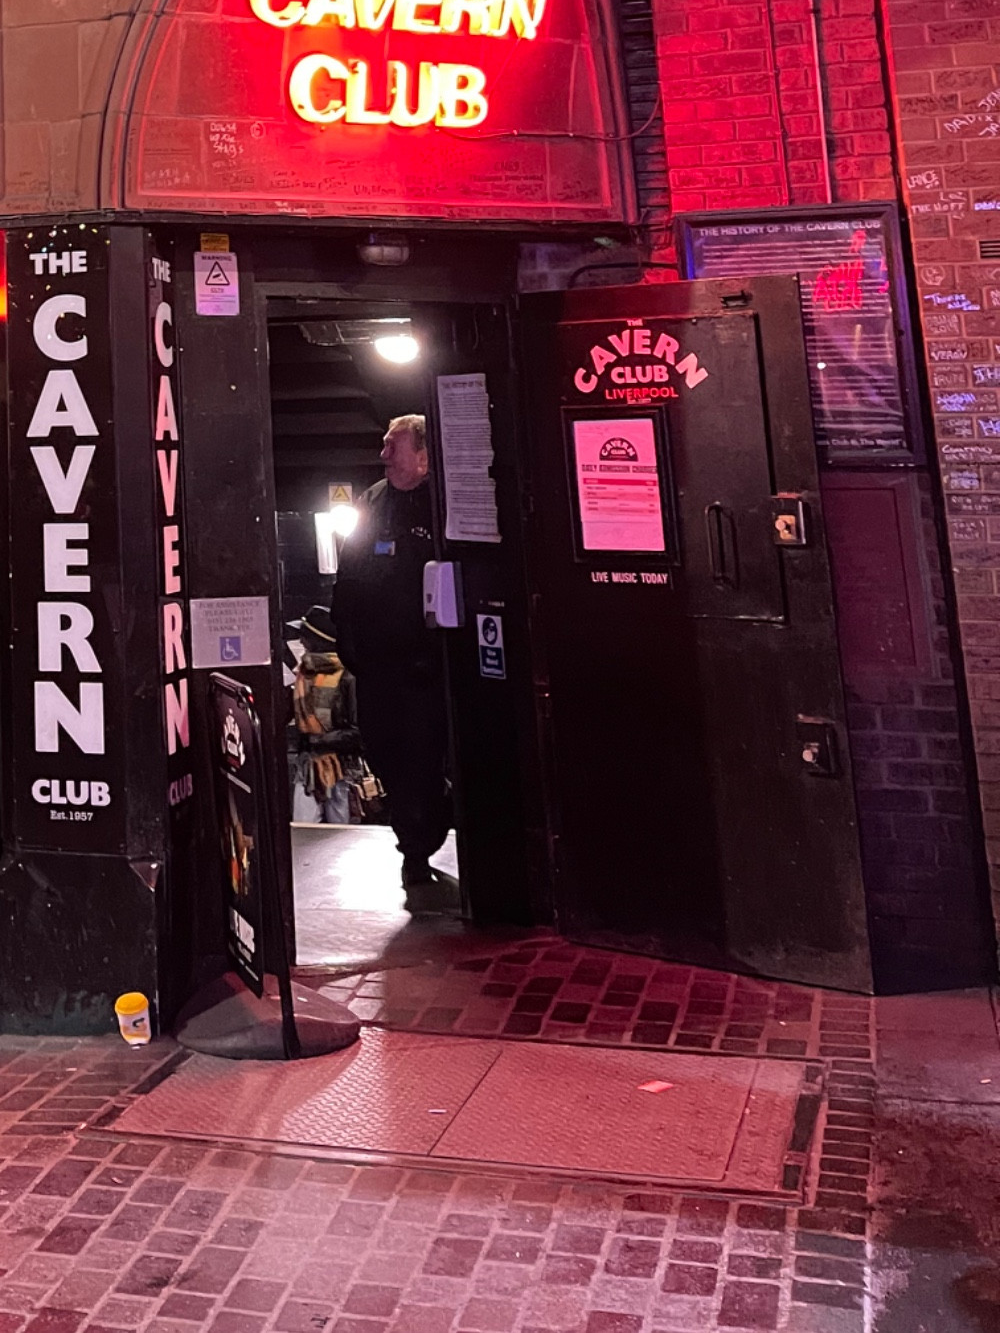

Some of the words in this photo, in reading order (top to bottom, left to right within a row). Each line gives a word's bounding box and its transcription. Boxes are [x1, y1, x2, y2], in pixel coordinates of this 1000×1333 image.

[289, 53, 488, 128] CLUB
[700, 229, 718, 237] THE
[720, 226, 764, 236] HISTORY
[766, 225, 781, 234] OF
[784, 224, 804, 233] THE
[806, 222, 848, 231] CAVERN
[850, 221, 881, 229] CLUB
[30, 251, 87, 275] THE
[152, 257, 171, 283] THE
[626, 318, 643, 326] THE
[574, 329, 709, 393] CAVERN
[611, 365, 669, 384] CLUB
[605, 387, 679, 400] LIVERPOOL
[601, 440, 635, 457] CAVERN
[26, 295, 105, 755] CAVERN
[155, 301, 190, 755] CAVERN
[591, 571, 609, 583] LIVE
[611, 572, 638, 584] MUSIC
[640, 572, 668, 585] TODAY
[31, 779, 111, 807] CLUB
[169, 773, 193, 806] CLUB
